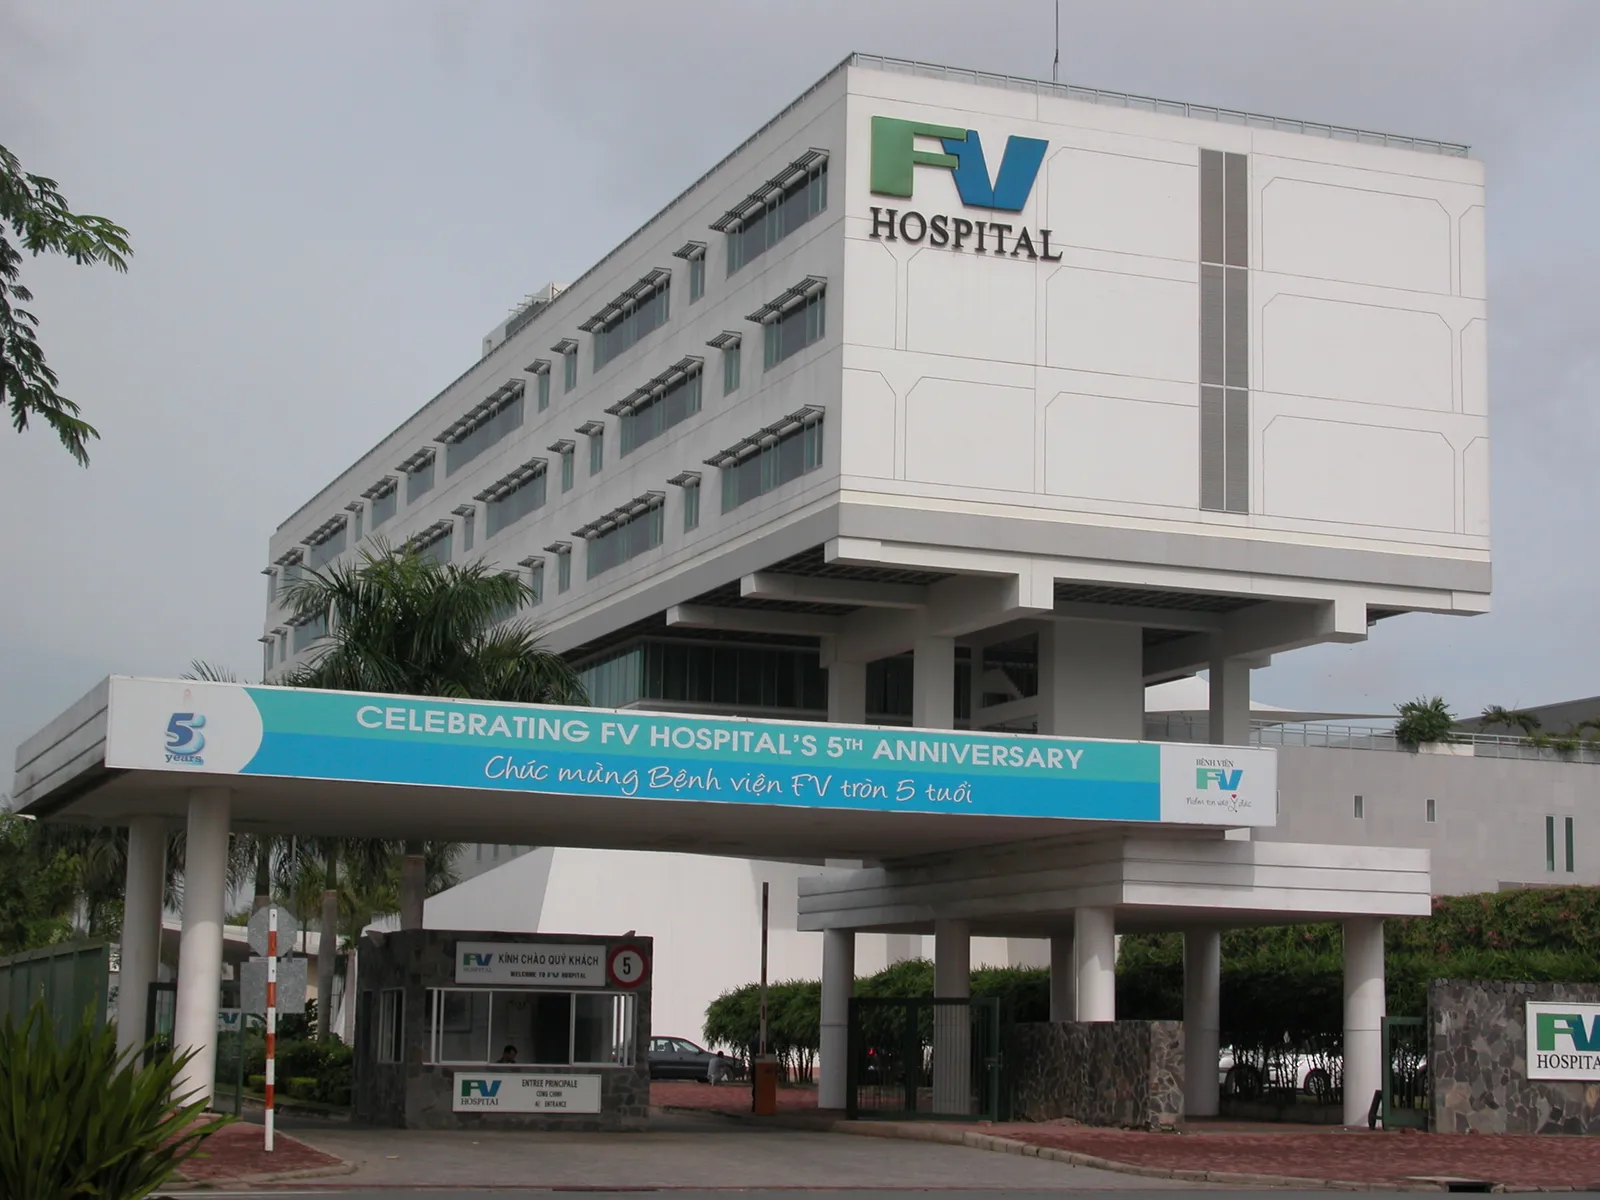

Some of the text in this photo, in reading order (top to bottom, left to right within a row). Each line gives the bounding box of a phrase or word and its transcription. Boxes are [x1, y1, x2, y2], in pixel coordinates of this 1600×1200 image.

[870, 115, 1049, 211] FV
[869, 206, 1063, 261] HOSPITAL
[165, 713, 206, 755] 5
[356, 705, 1084, 769] CELEBRATING FV HOSPITAL'S 5TH ANNIVERSARY
[165, 754, 202, 763] years
[484, 755, 973, 804] Chúc mừng Bệnh viện FV tròn 5 tuổi
[1196, 767, 1243, 791] FV
[463, 952, 493, 966] FV
[498, 952, 599, 966] KÍNH CHÀO QUÝ KHÁCH
[622, 956, 631, 975] 5
[1536, 1013, 1600, 1051] FV
[461, 1080, 502, 1097] FV
[545, 1079, 578, 1088] PRINCIPALE
